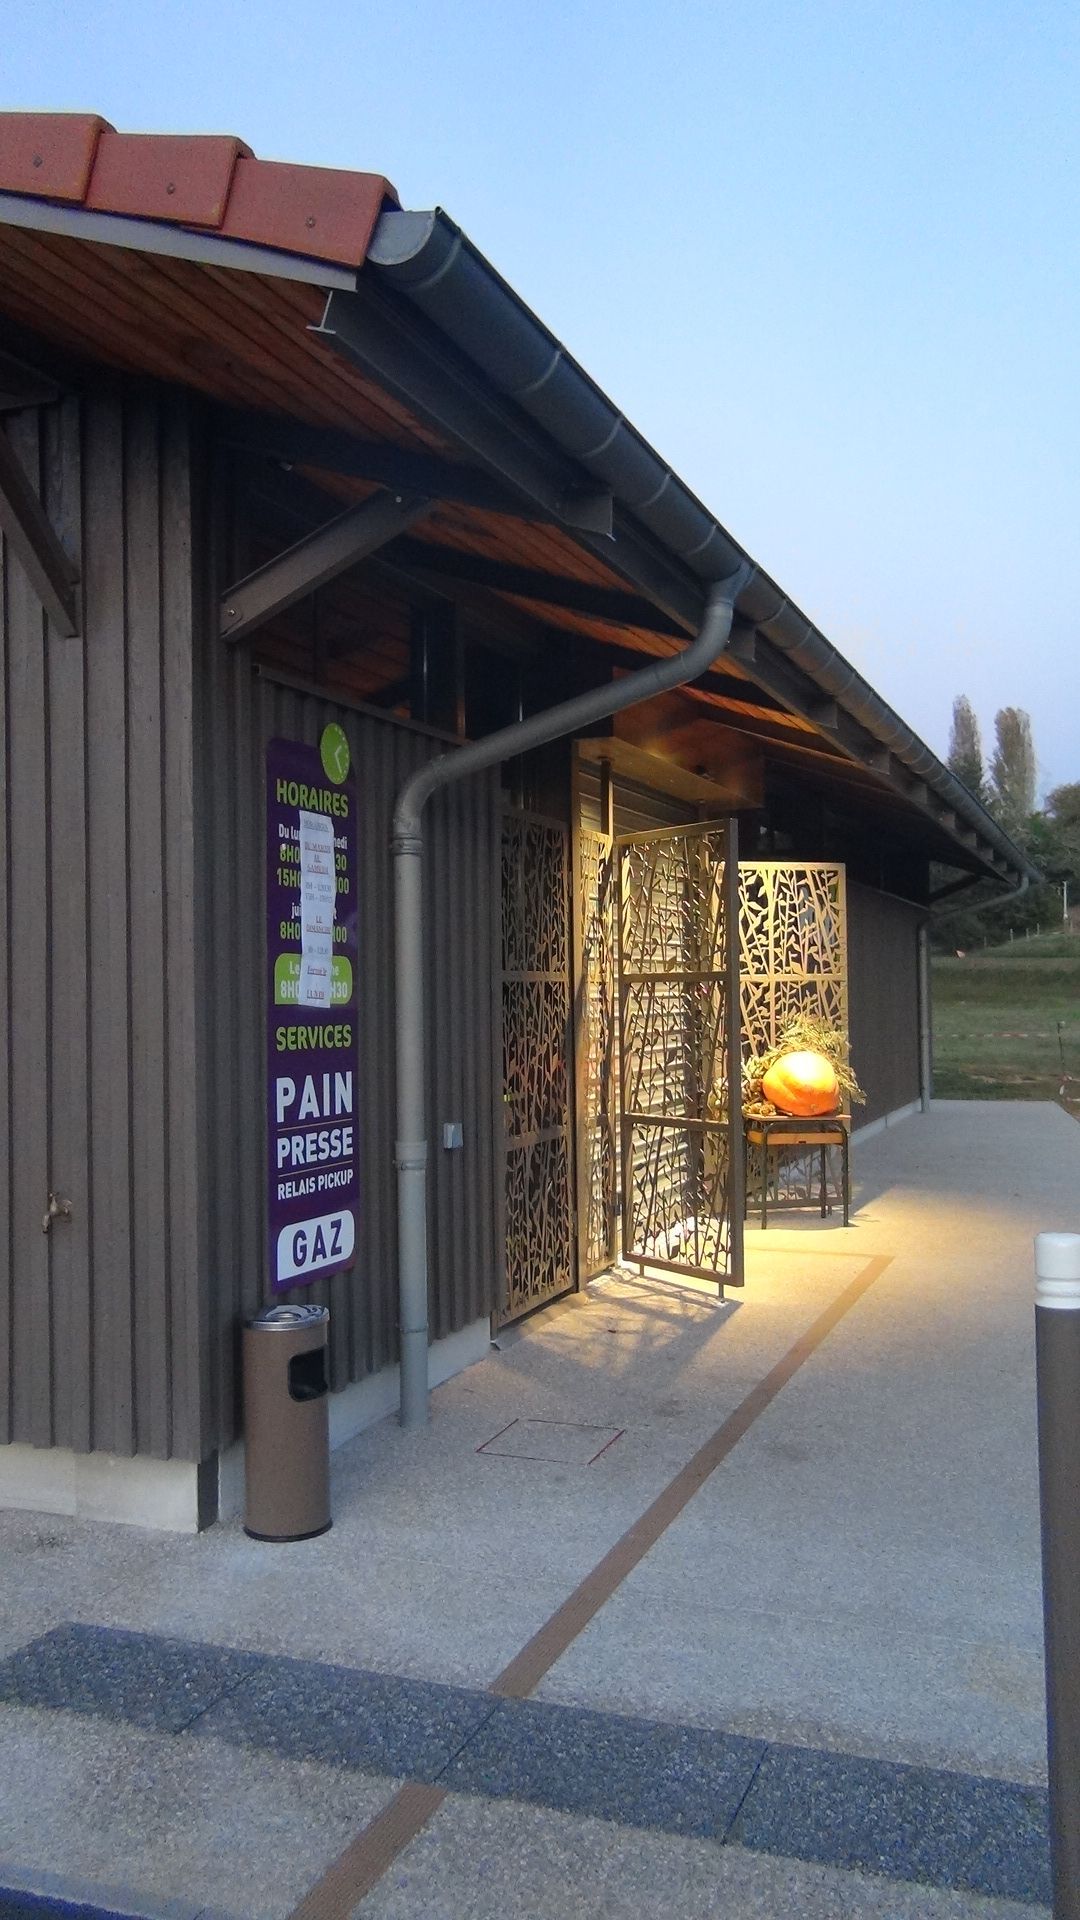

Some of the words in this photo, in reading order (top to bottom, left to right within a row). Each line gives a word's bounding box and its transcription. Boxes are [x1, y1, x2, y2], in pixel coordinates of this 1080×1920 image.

[276, 779, 349, 818] HORAIRES
[278, 824, 290, 838] Du
[280, 844, 301, 864] 8H0
[280, 921, 301, 940] 8H0
[275, 1024, 352, 1051] SERVICES
[276, 1071, 353, 1123] PAIN
[277, 1126, 353, 1169] PRESSE
[277, 1176, 316, 1201] RELAIS
[317, 1168, 354, 1192] PICKUP
[292, 1218, 342, 1268] GAZ
